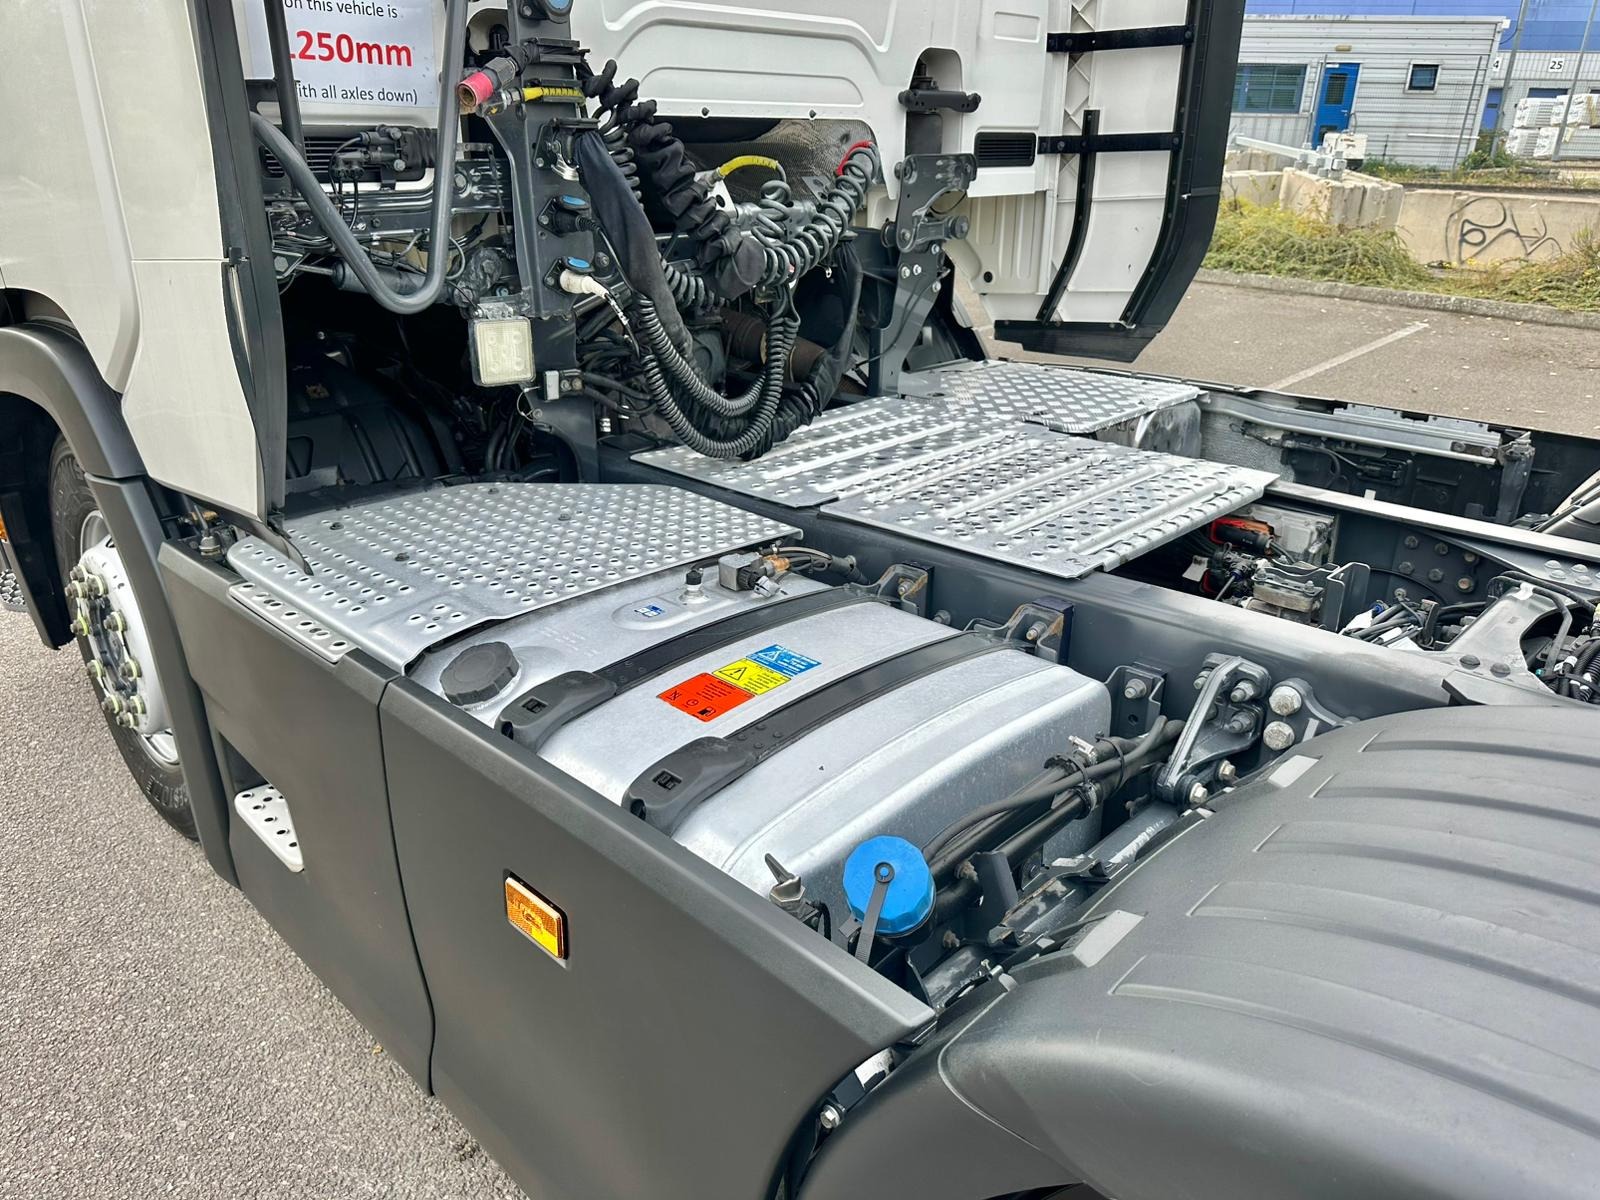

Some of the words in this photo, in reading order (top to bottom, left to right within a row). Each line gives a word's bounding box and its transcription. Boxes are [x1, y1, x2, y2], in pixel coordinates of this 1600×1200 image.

[285, 0, 302, 8] on
[307, 0, 333, 11] this
[336, 0, 384, 17] vehicle
[387, 4, 398, 19] is
[290, 30, 413, 67] 250mm
[1493, 60, 1500, 69] 4
[1549, 60, 1564, 70] 25
[298, 83, 317, 98] ith
[321, 84, 337, 99] all
[341, 86, 374, 101] axles
[378, 87, 418, 105] down)
